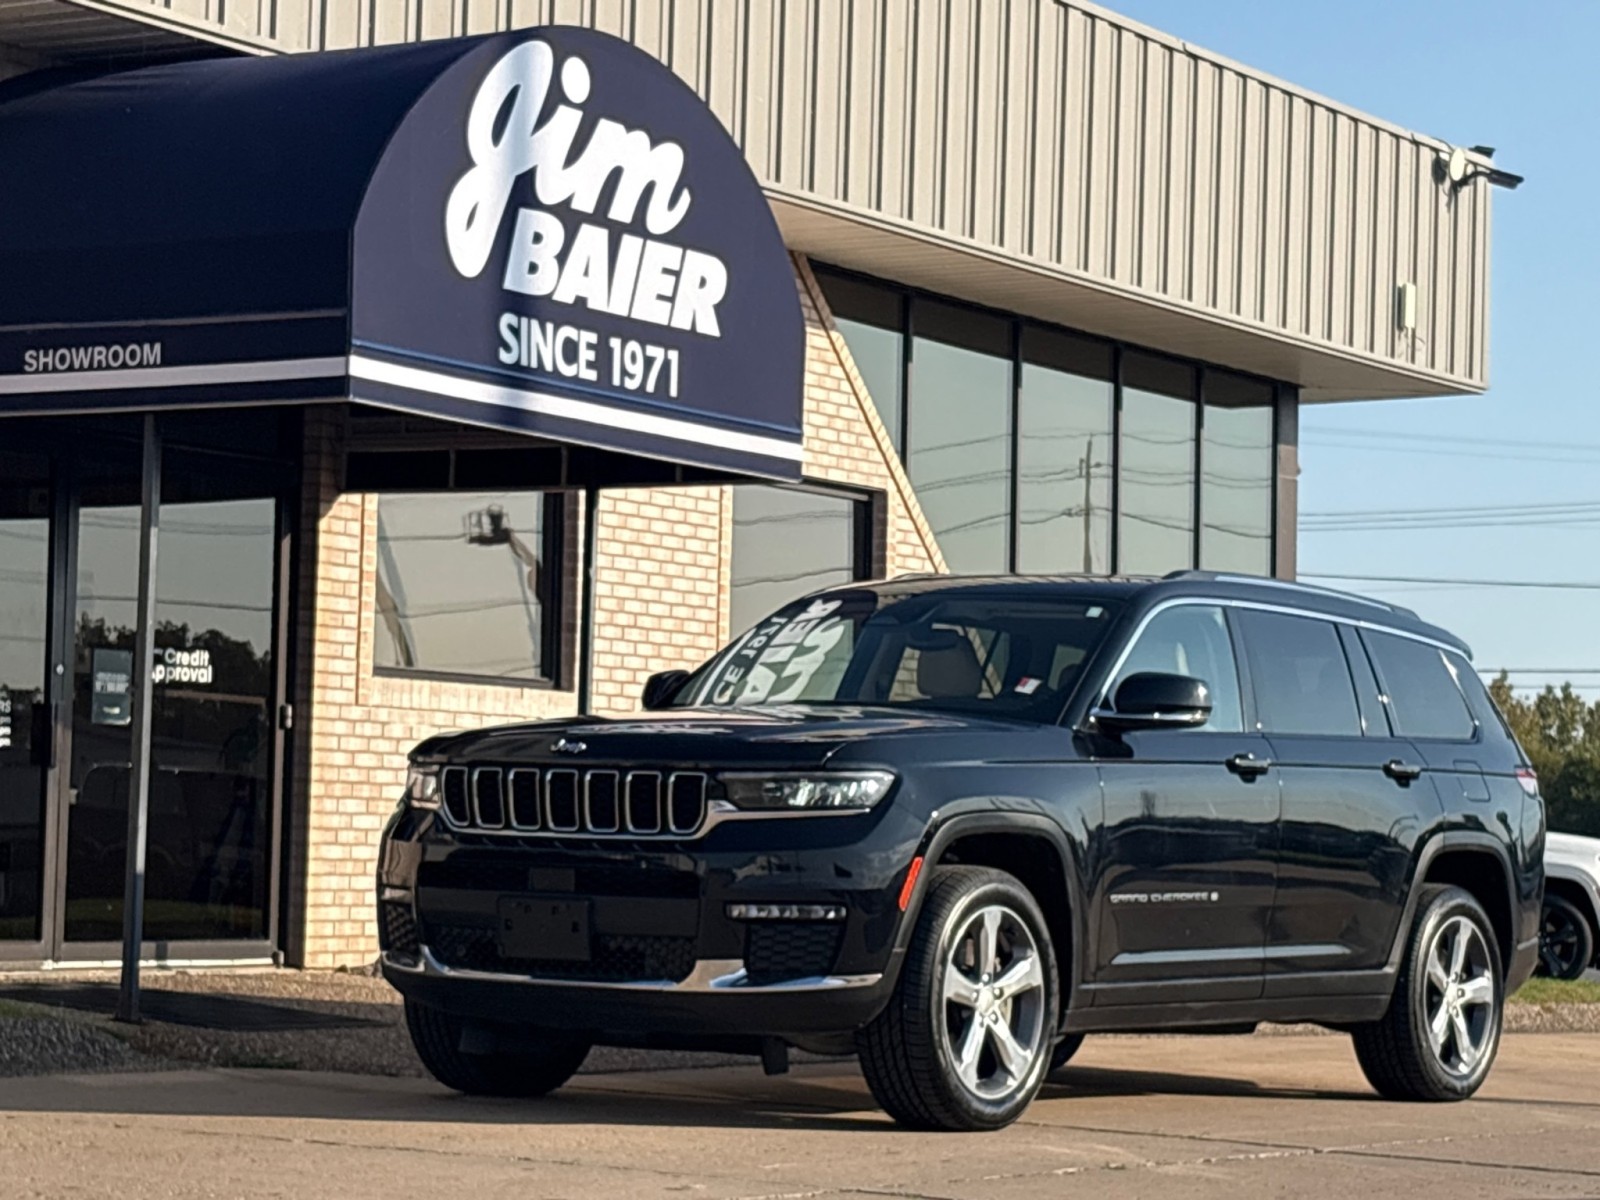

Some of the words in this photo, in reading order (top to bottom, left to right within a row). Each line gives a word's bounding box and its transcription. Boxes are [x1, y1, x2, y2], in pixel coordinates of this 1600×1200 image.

[446, 40, 691, 278] Jim
[502, 207, 728, 338] BAIER
[24, 342, 162, 372] SHOWROOM
[498, 312, 599, 382] SINCE
[609, 336, 680, 398] 1971
[152, 664, 213, 684] pproval
[164, 648, 210, 667] Credit
